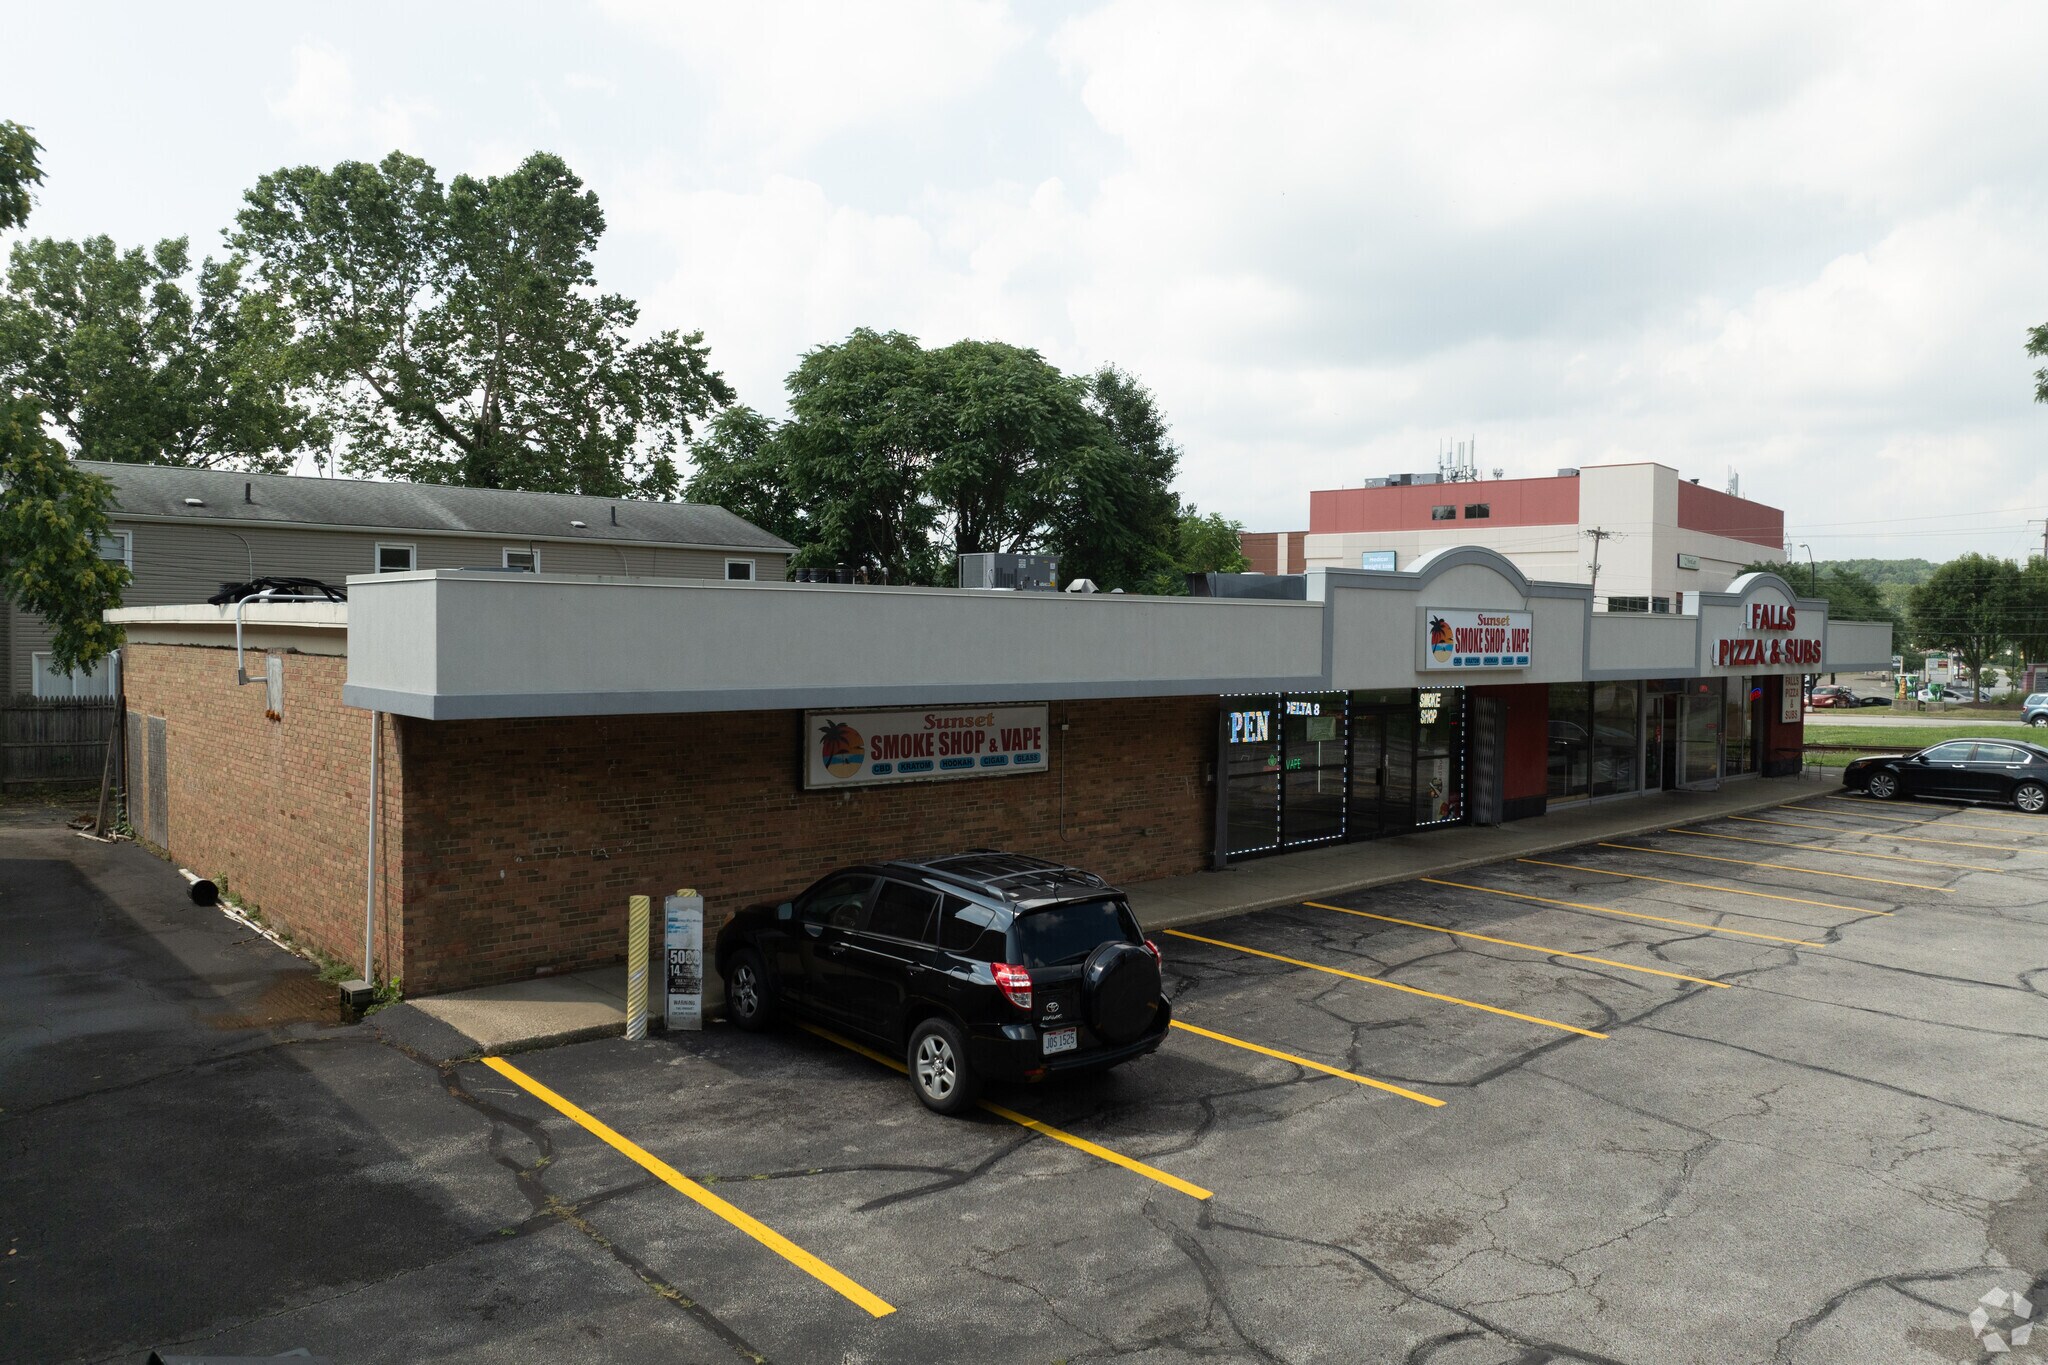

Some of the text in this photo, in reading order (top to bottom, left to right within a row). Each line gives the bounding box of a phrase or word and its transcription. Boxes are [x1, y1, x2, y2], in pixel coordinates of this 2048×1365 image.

[1477, 613, 1511, 627] Sunset
[1752, 603, 1796, 631] FALLS
[1455, 627, 1530, 654] SMOKE SHOP & VAPE
[1719, 639, 1822, 666] PIZZA & SUBS
[1785, 677, 1799, 686] FALLS
[1785, 689, 1799, 697] PIZZA
[1419, 693, 1441, 708] SMOKE
[1313, 703, 1320, 716] 8
[1784, 710, 1798, 720] SUBS
[923, 712, 995, 730] Sunset
[1419, 709, 1438, 724] SHOP
[1228, 711, 1270, 743] PEN
[870, 726, 1041, 761] SMOKE SHOP & VAPE
[942, 758, 973, 768] HOOKAH
[983, 756, 1005, 765] CIGAR
[1016, 753, 1038, 762] GLASS
[1285, 758, 1301, 770] VAPE
[873, 764, 891, 773] CBD
[900, 761, 932, 771] KRATOM
[670, 964, 680, 977] 14
[1046, 1033, 1075, 1049] JOS 1525
